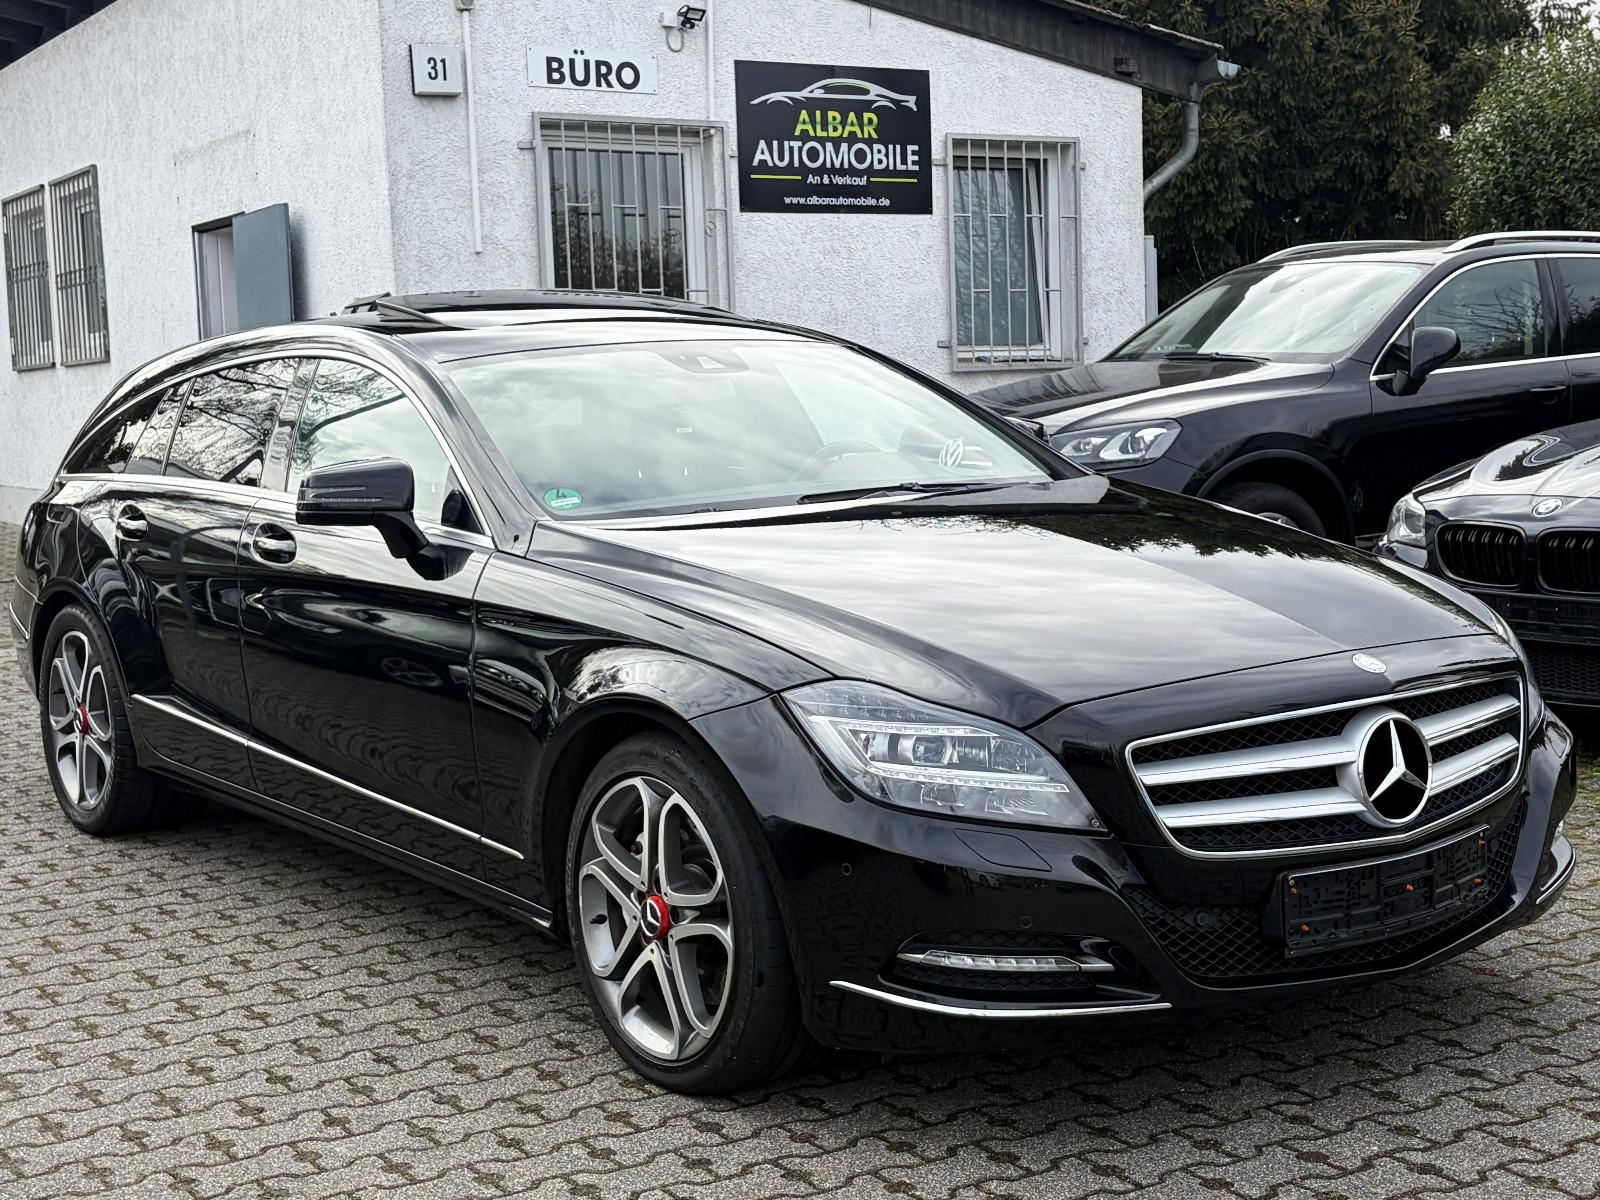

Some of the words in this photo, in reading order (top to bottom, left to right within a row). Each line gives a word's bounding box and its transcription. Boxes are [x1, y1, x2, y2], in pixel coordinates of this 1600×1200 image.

[427, 56, 448, 81] 31
[545, 49, 641, 90] BÜRO
[794, 109, 879, 138] ALBAR
[752, 139, 920, 171] AUTOMOBILE
[806, 174, 820, 185] An
[823, 174, 830, 185] &
[831, 175, 868, 186] Verkauf
[784, 195, 891, 207] www.albarautomobile.de
